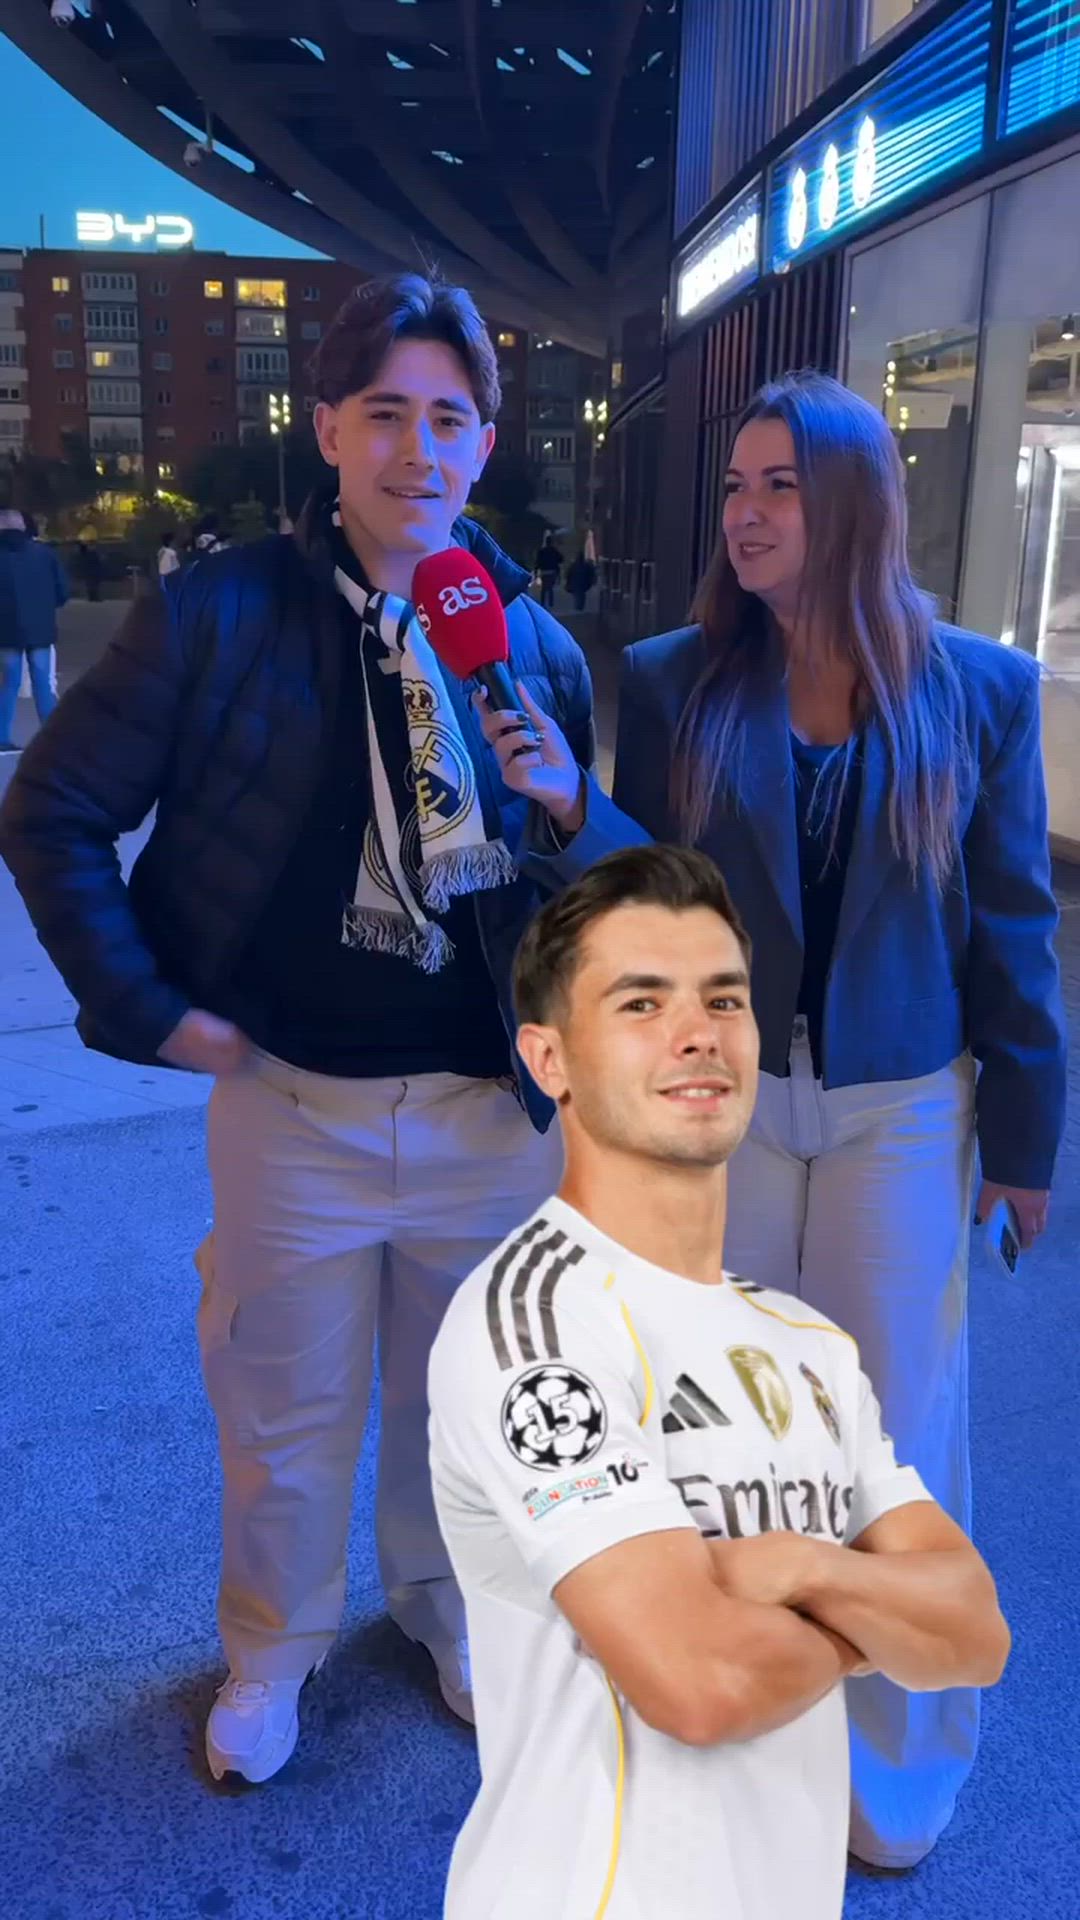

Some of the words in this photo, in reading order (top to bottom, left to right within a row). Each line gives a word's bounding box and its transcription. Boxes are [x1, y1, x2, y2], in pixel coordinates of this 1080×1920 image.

[76, 211, 193, 243] BYD
[438, 577, 488, 616] as
[525, 1394, 579, 1444] 15
[668, 1462, 854, 1540] Emirates
